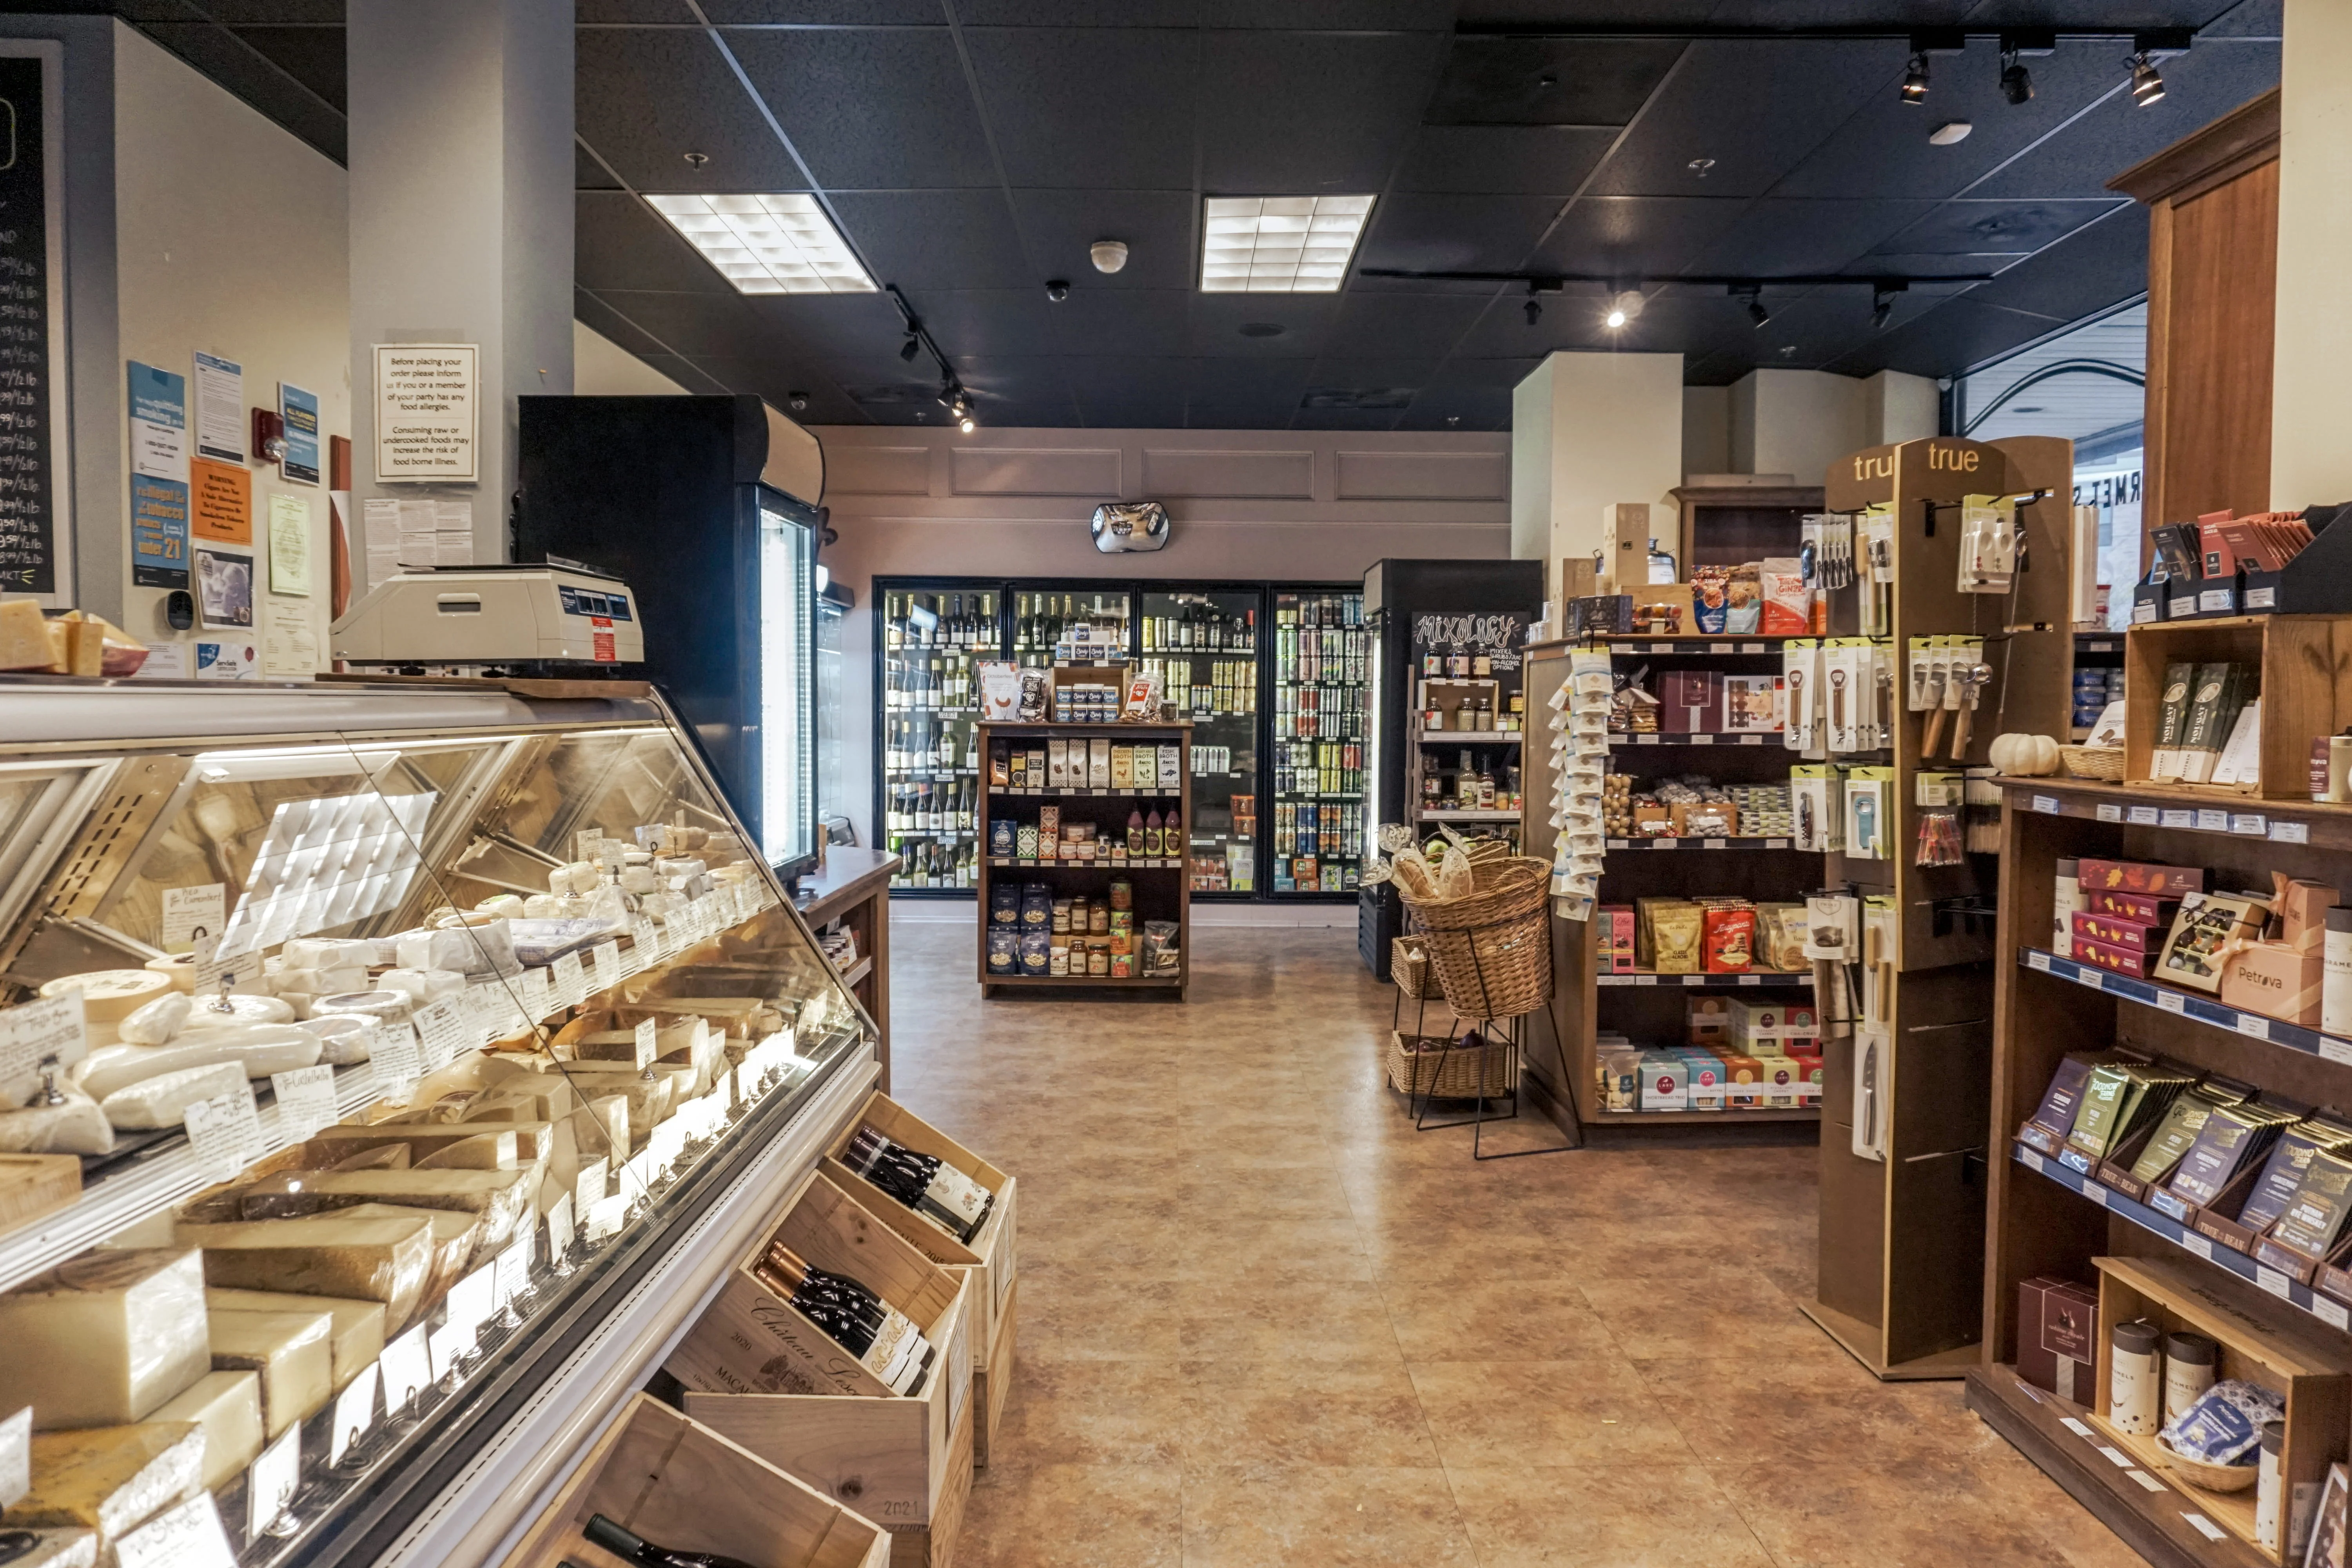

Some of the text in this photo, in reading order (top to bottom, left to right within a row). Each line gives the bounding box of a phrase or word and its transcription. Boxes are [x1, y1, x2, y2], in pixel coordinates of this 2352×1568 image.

[416, 358, 441, 366] placing
[136, 407, 171, 425] smoking
[420, 403, 450, 412] allergies.
[1853, 456, 1894, 481] tru
[1929, 443, 1979, 472] true
[165, 538, 181, 560] 21
[2163, 705, 2174, 742] NOUGAT
[2190, 705, 2205, 743] NOUGAT
[2101, 1168, 2139, 1195] TRUE BEAN
[2199, 1222, 2217, 1236] TRUE
[2224, 1233, 2245, 1250] BEAN
[730, 1331, 752, 1351] 2020
[884, 1501, 918, 1516] 2021
